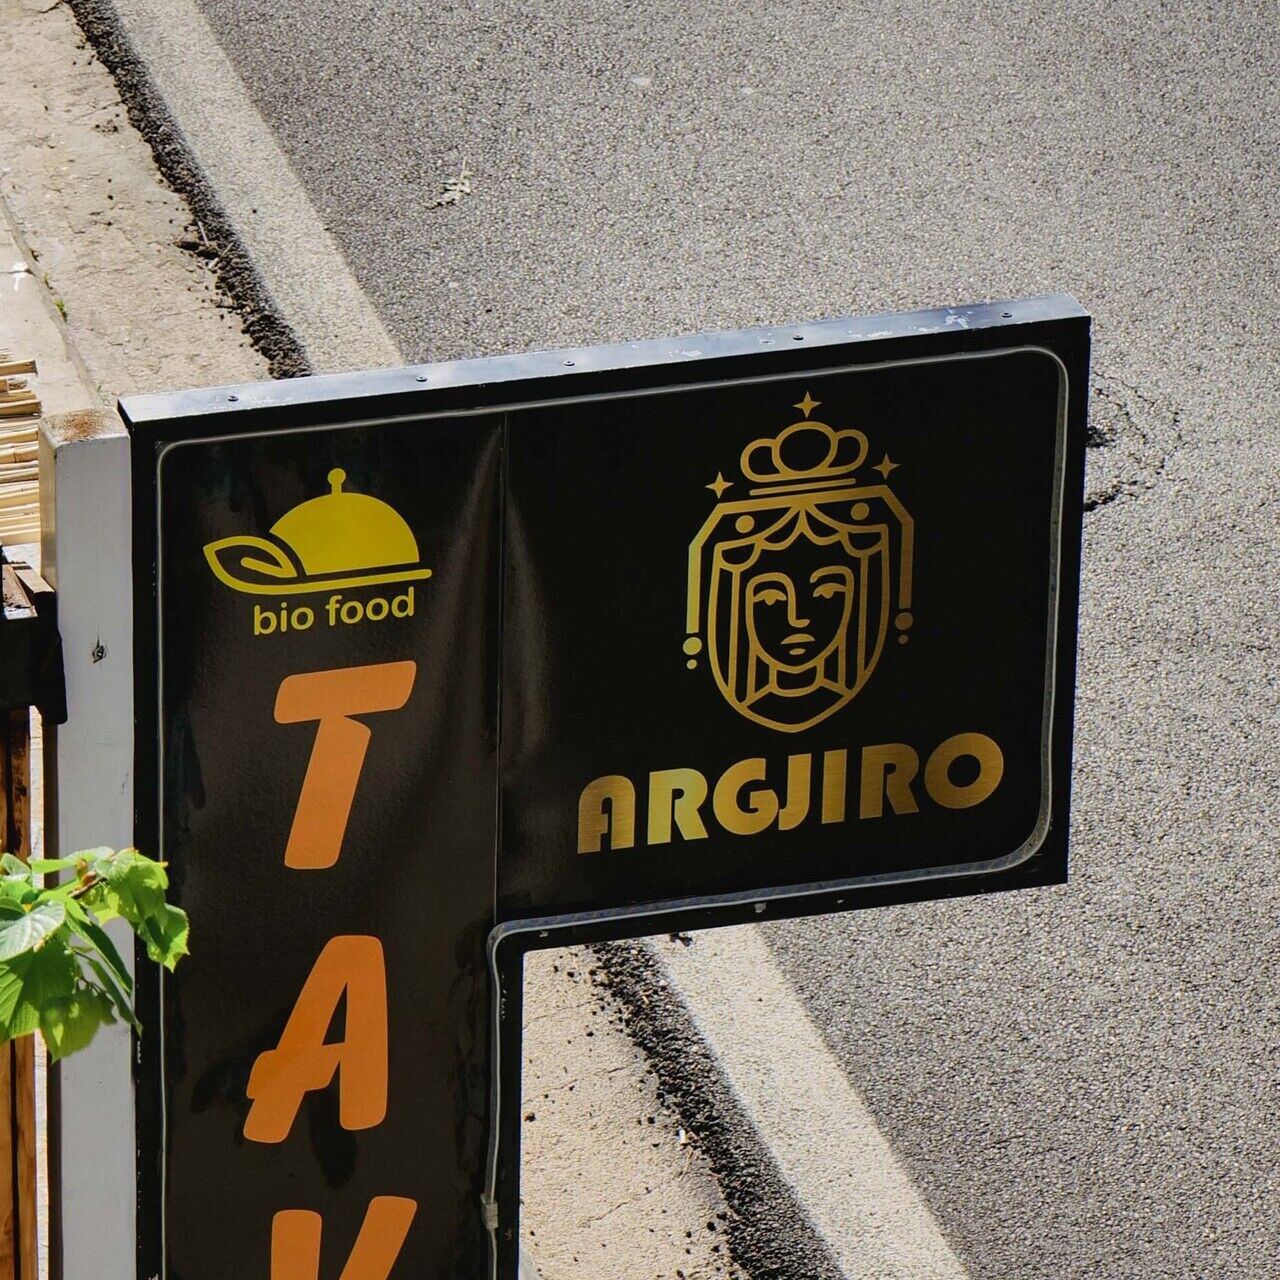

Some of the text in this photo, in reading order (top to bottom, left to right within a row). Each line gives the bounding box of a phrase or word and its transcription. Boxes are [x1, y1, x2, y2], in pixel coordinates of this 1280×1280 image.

[253, 585, 415, 636] bio food
[577, 732, 1005, 854] ARGJIRO
